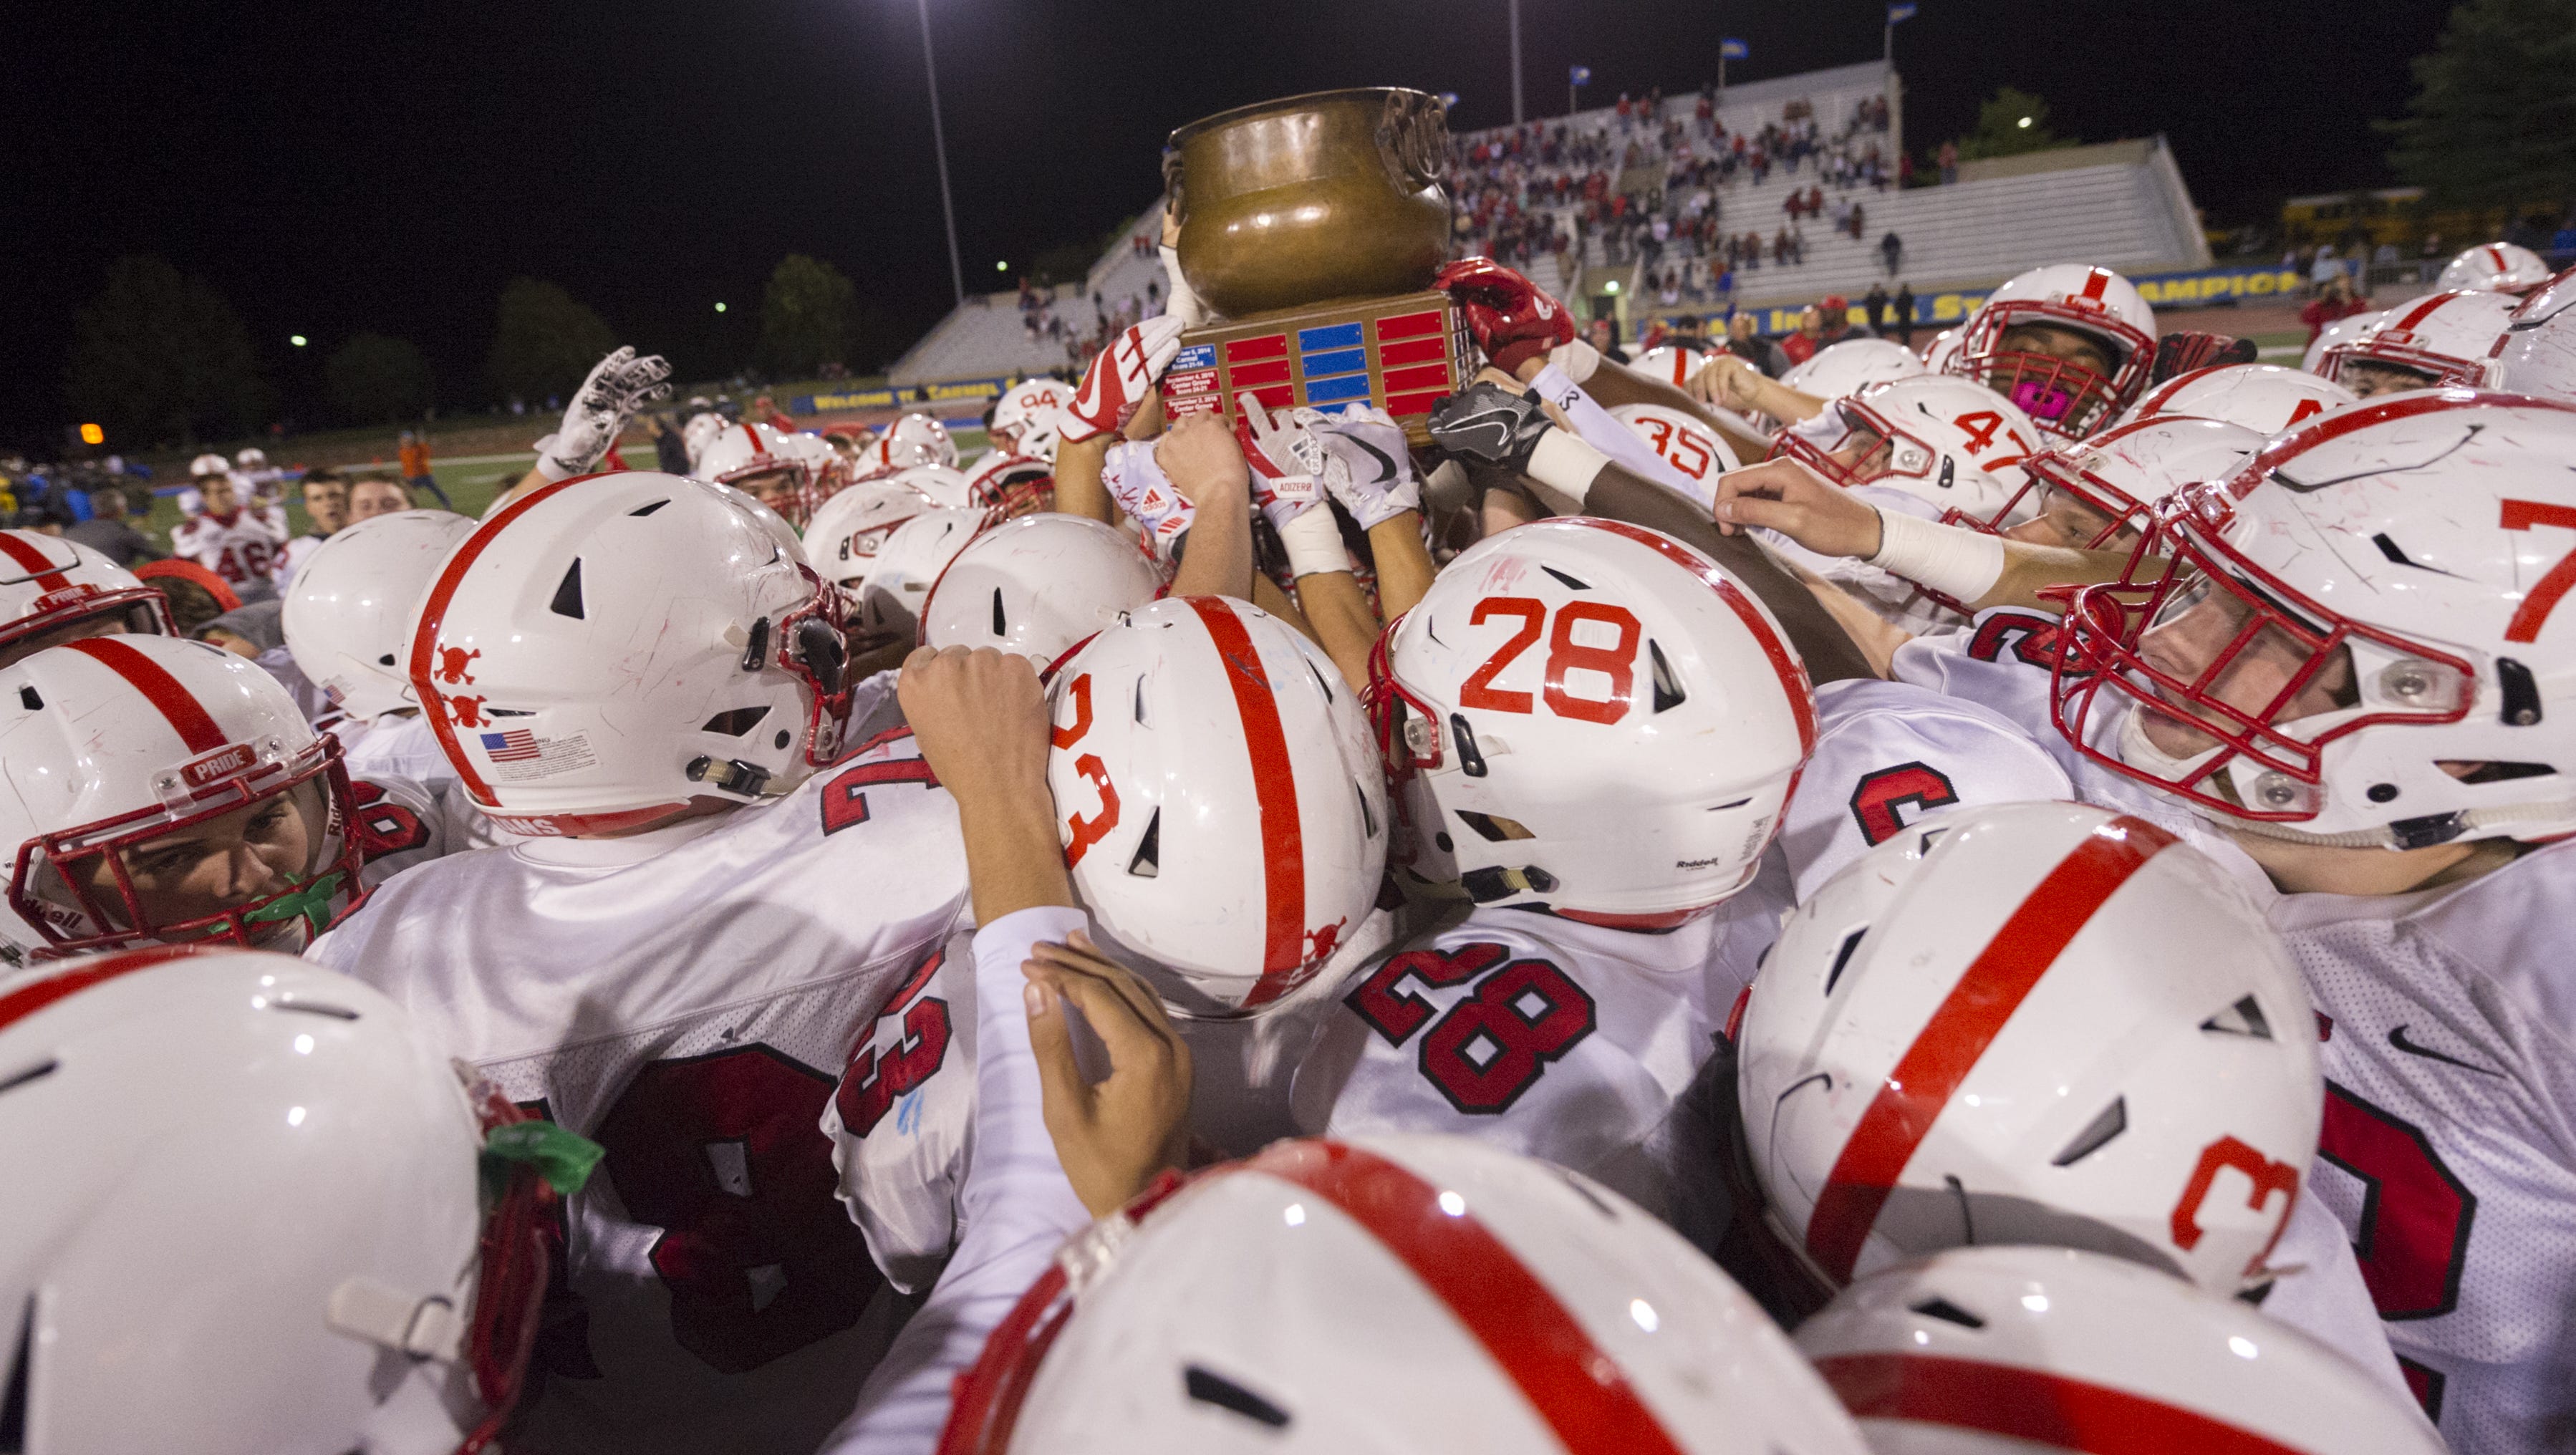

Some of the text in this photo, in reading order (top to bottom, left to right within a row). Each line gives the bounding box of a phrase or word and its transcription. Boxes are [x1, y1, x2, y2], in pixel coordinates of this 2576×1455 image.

[1165, 375, 1194, 385] September
[1021, 389, 1058, 417] 94
[1169, 399, 1197, 407] September
[1634, 417, 1710, 480] 35
[1953, 410, 2035, 473] 47
[1142, 501, 1167, 513] adidas
[1460, 596, 1641, 725] 28
[193, 749, 246, 781] PRIDE
[1344, 941, 1597, 1115] 28
